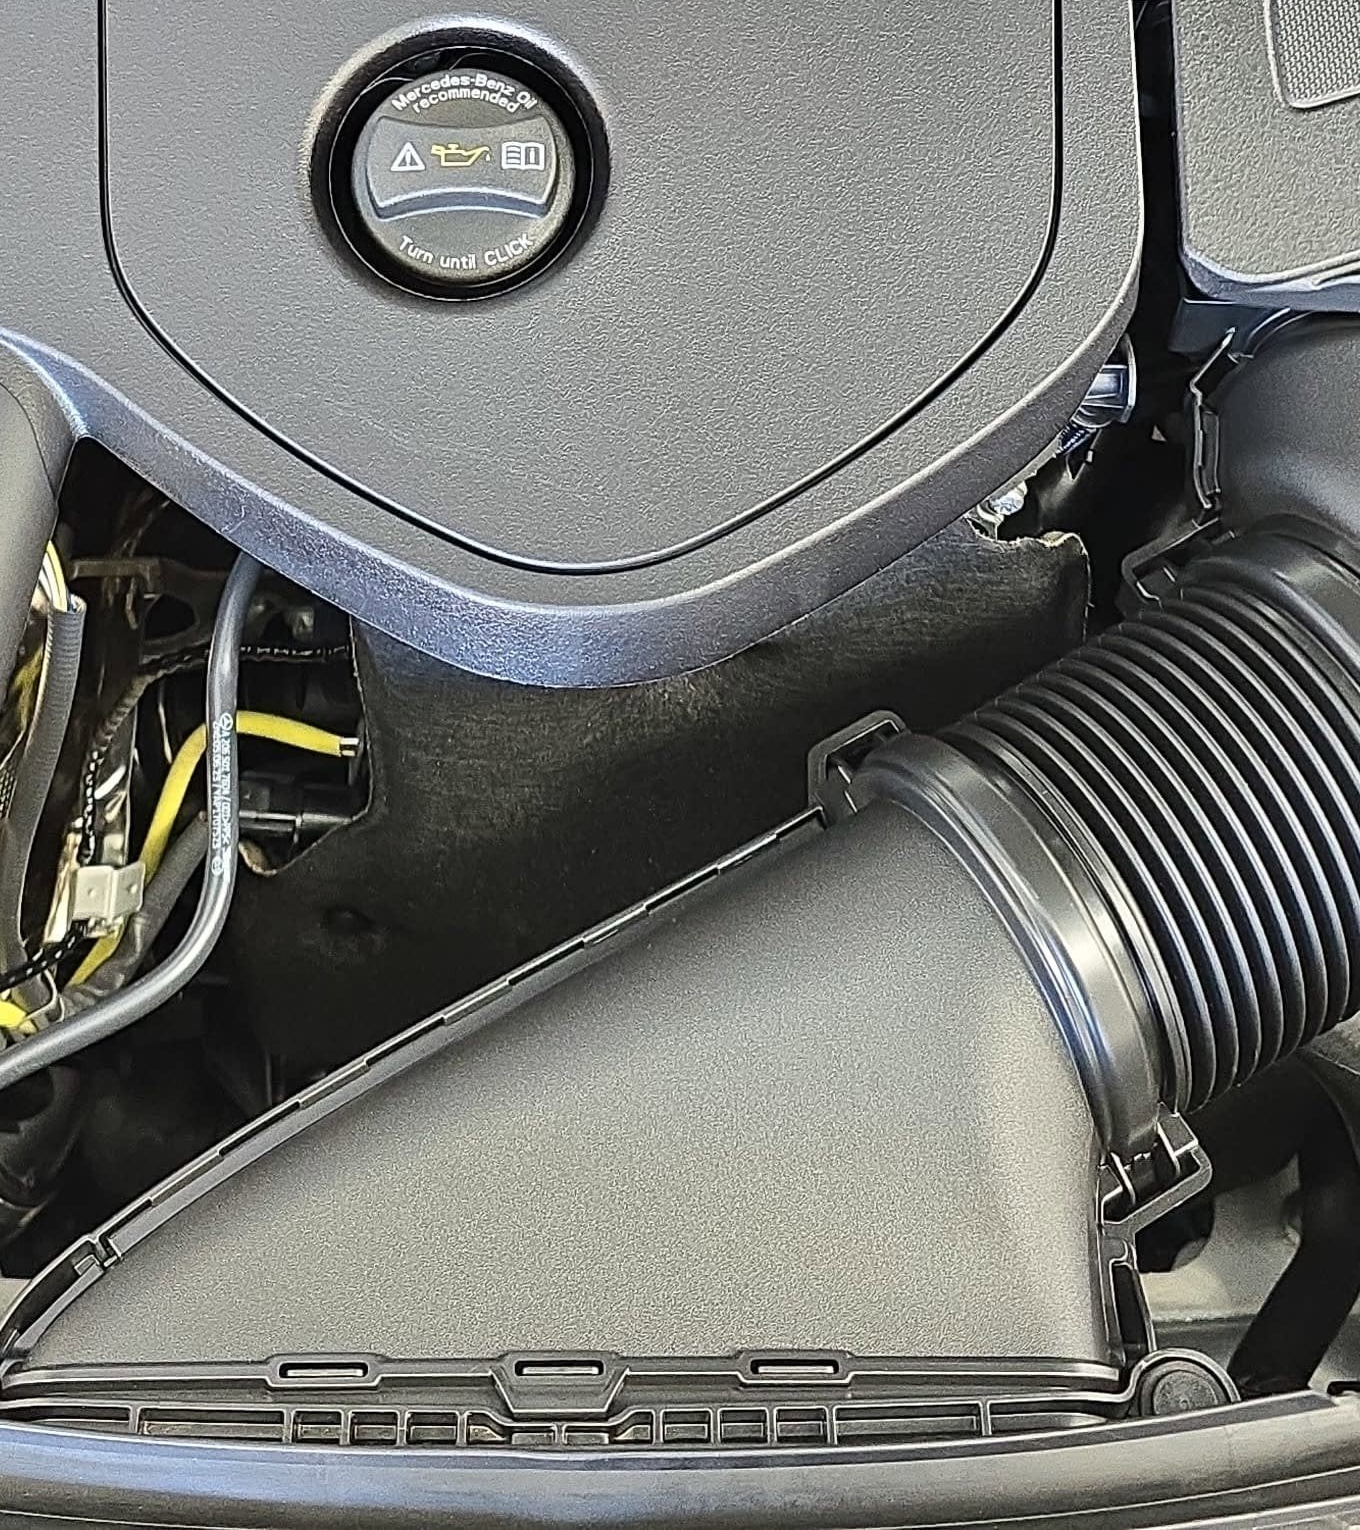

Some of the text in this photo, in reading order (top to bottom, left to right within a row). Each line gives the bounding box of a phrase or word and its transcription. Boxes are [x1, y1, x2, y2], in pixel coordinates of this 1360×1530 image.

[391, 73, 538, 111] Mercedes-Benz Oil
[412, 87, 521, 113] recommended
[399, 233, 534, 270] Turn until CLICK
